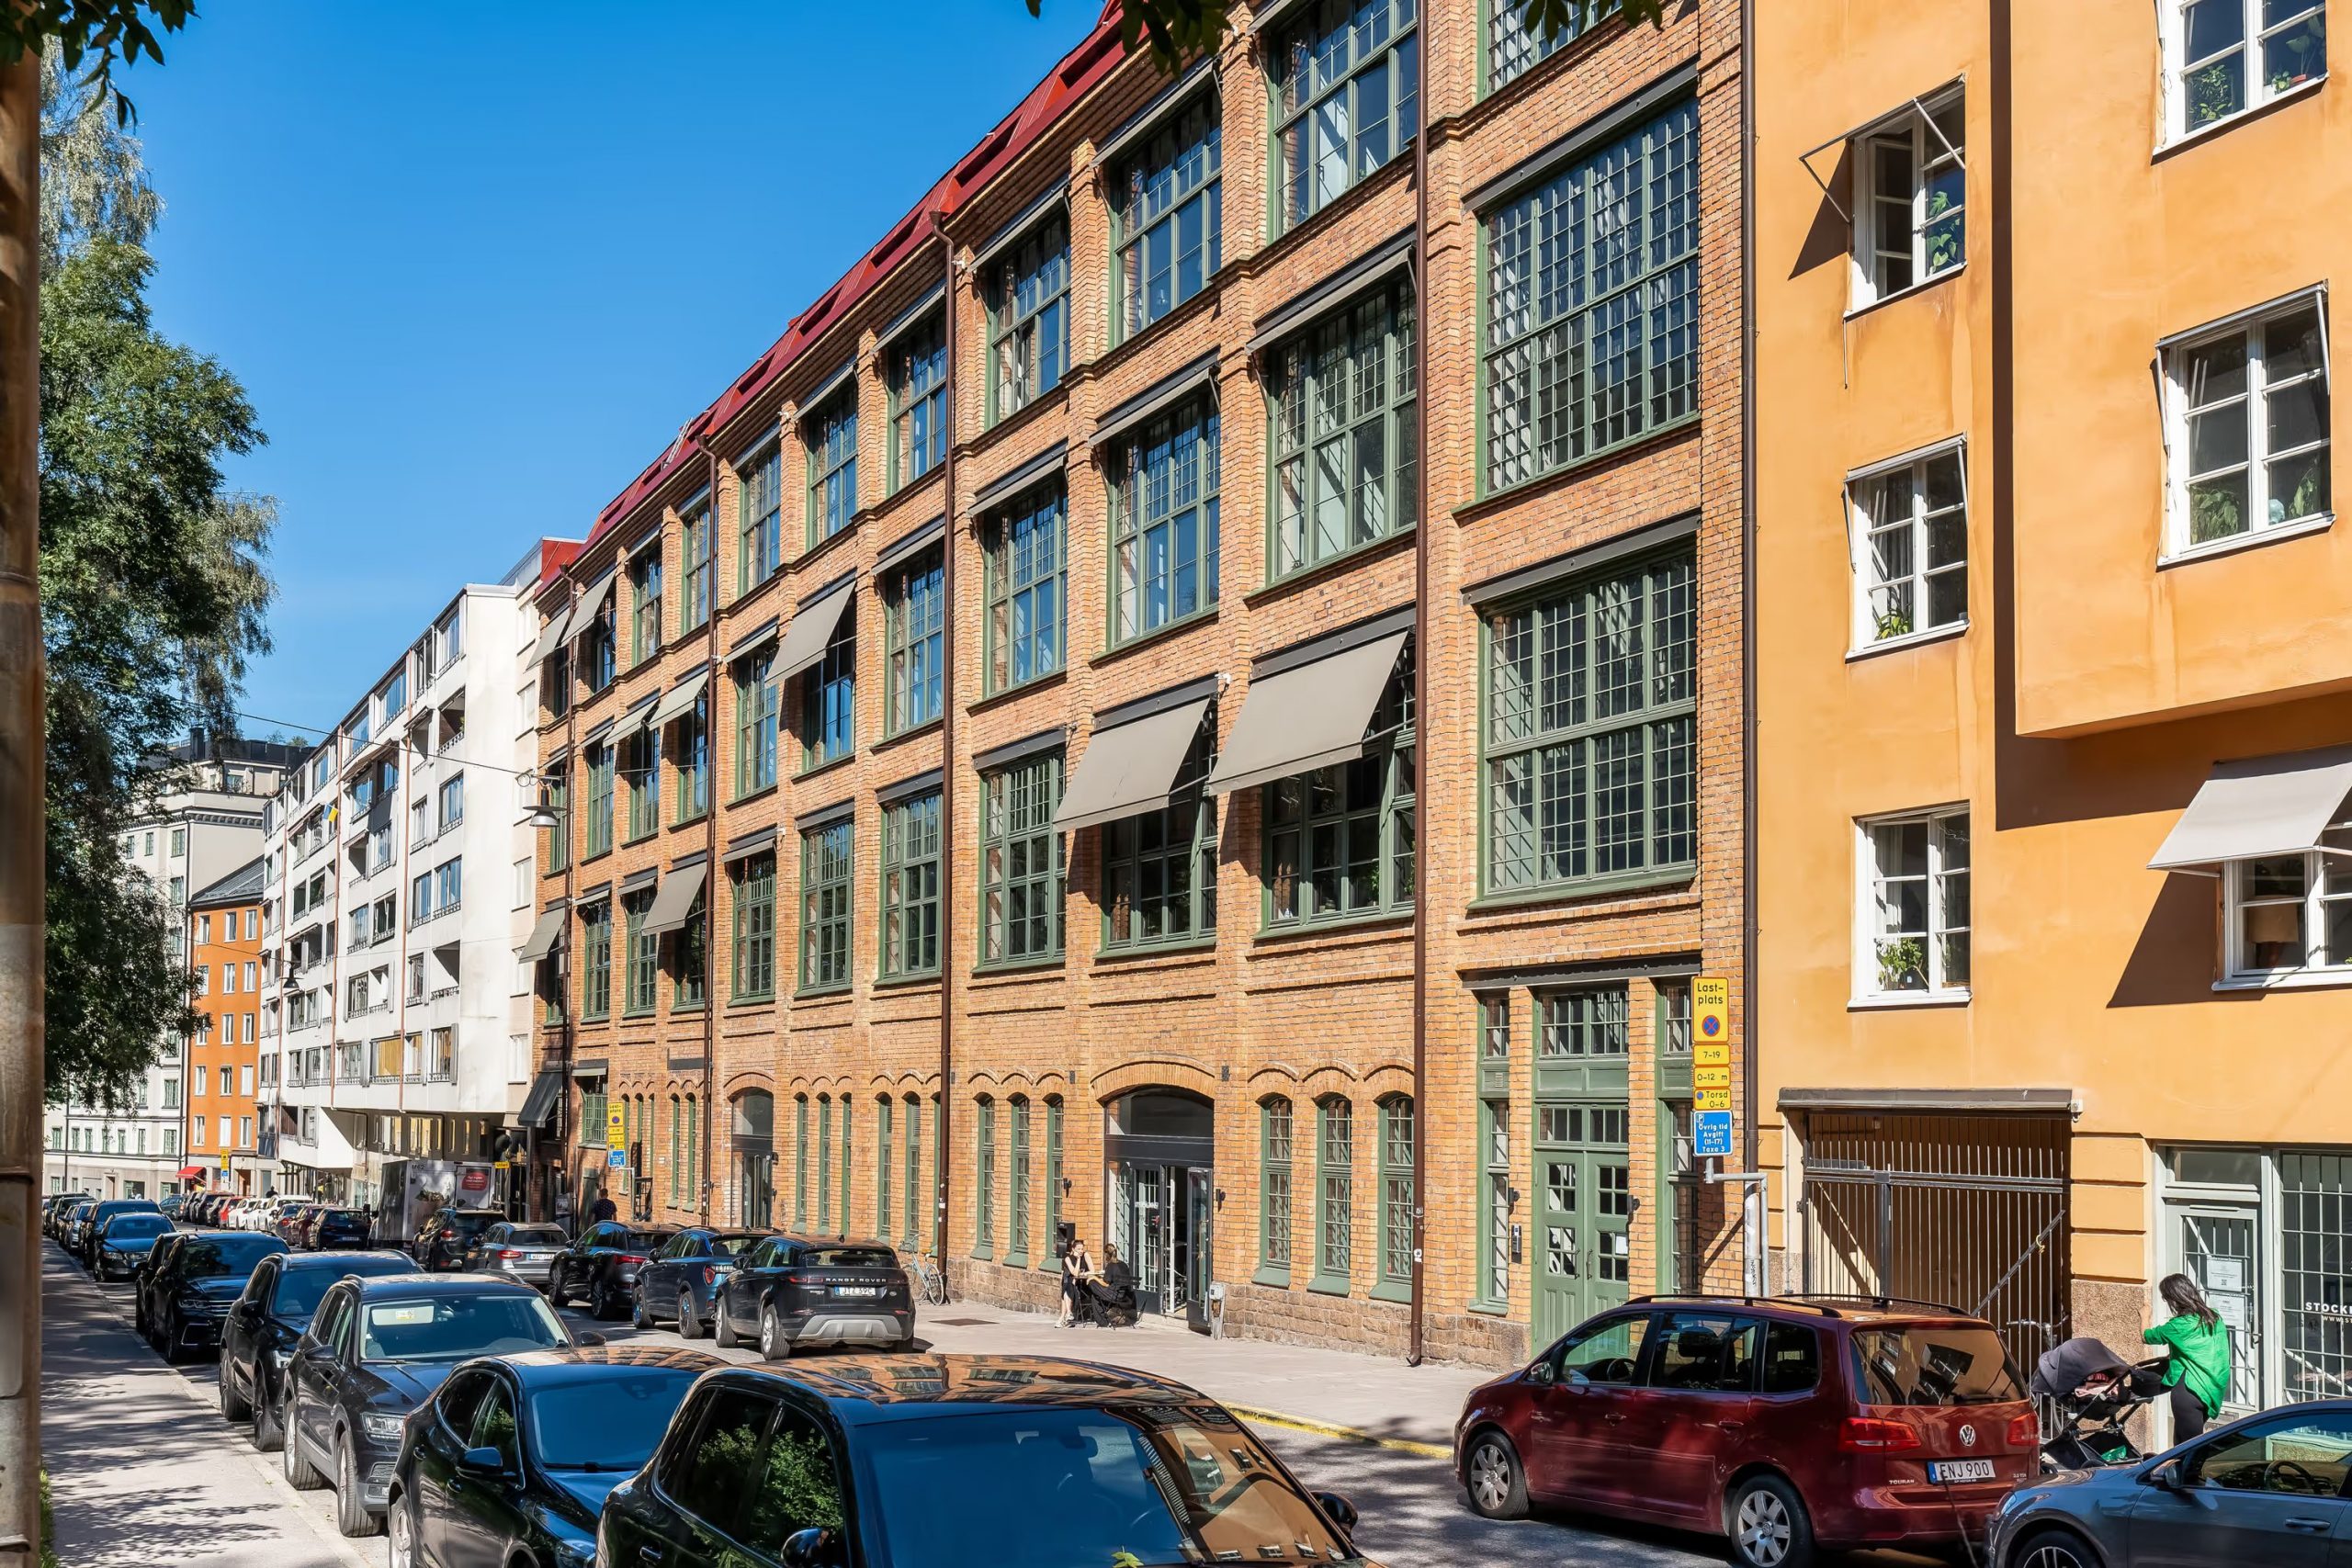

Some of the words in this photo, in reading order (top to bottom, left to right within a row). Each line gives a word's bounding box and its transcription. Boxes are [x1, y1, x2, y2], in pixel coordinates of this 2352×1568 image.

[1697, 983, 1724, 992] Last-
[1698, 995, 1724, 1006] plats
[1703, 1051, 1721, 1059] 7-19
[1697, 1073, 1715, 1081] 0-12
[1705, 1090, 1728, 1099] Torsd
[1698, 1122, 1717, 1131] Övrig
[1939, 1464, 1963, 1479] ENJ
[1965, 1461, 1990, 1476] 900
